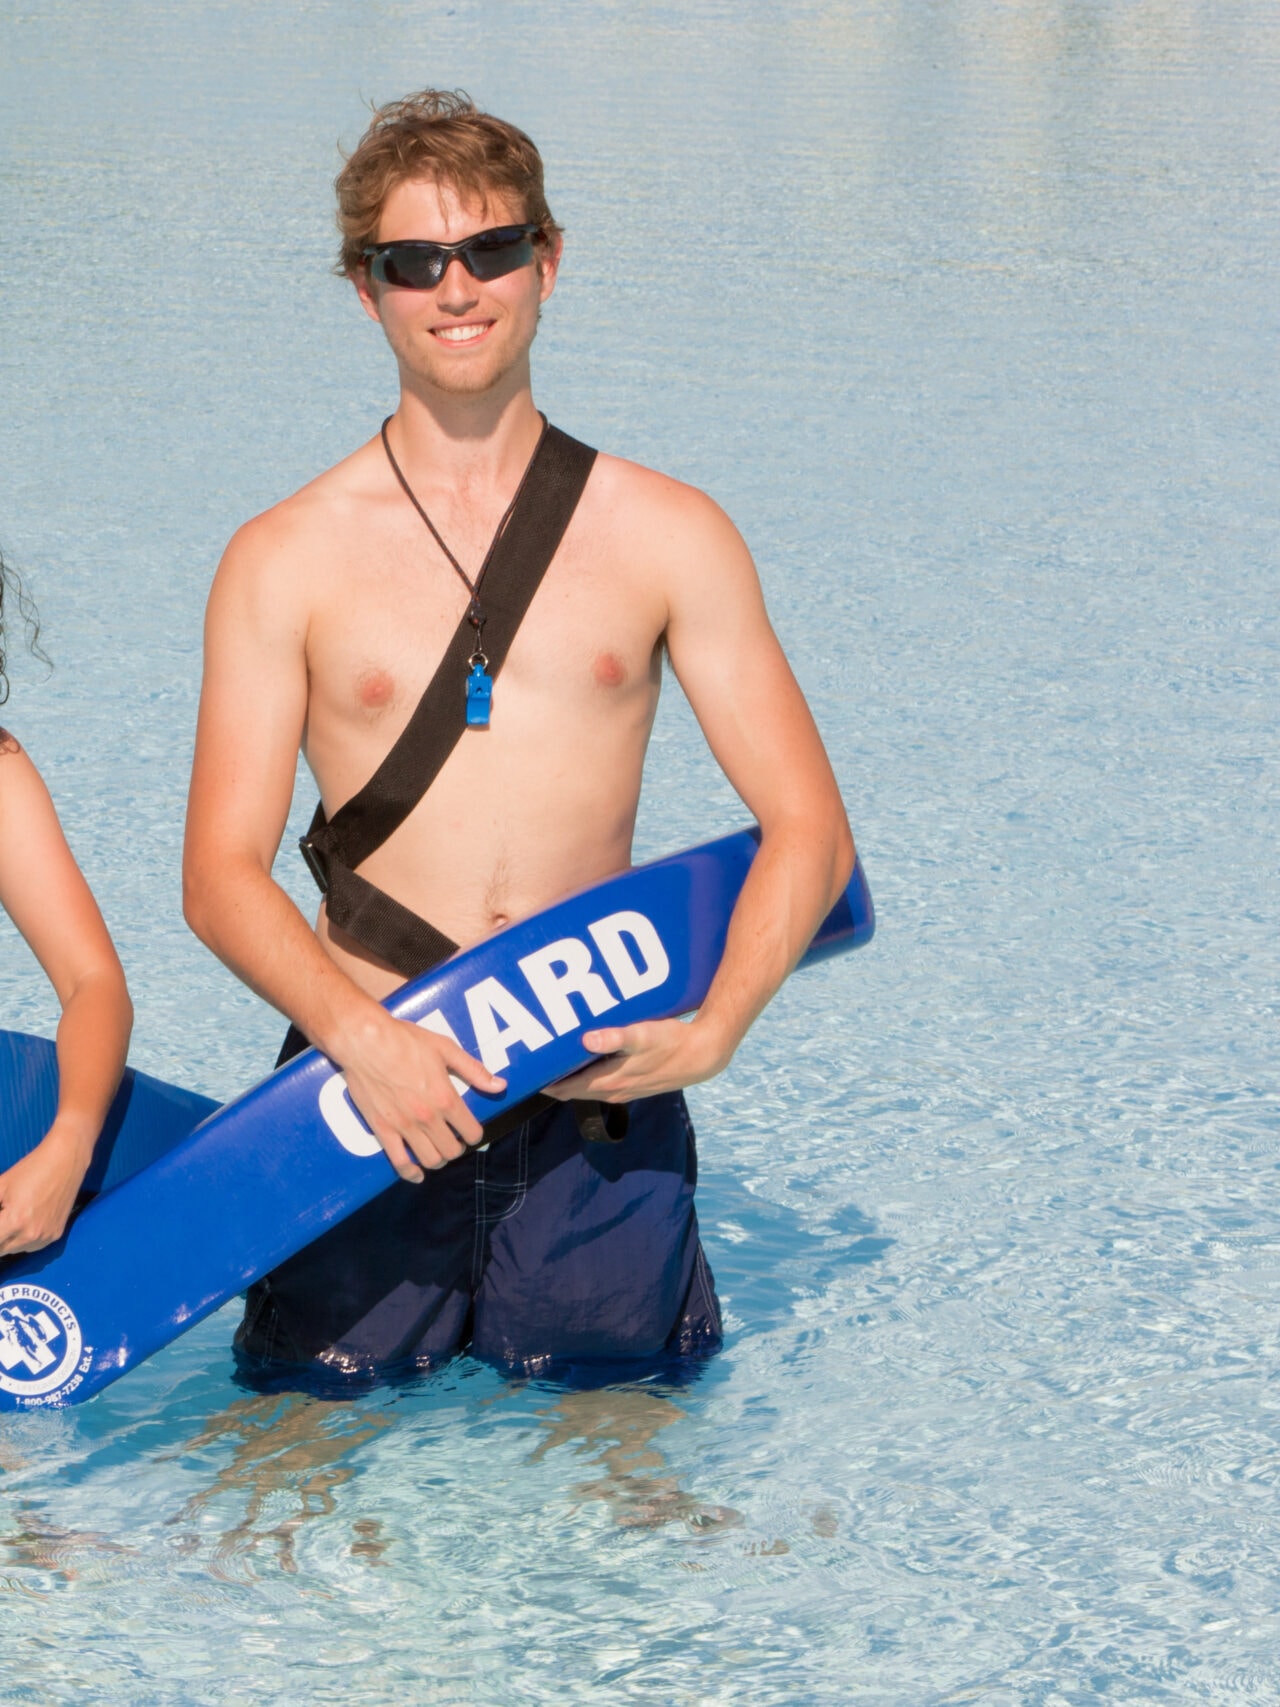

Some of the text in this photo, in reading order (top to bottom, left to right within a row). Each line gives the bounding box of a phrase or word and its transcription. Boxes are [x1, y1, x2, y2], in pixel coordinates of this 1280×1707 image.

[11, 1287, 77, 1331] PRODUCTS
[83, 1345, 94, 1355] 4
[79, 1354, 94, 1374] Ext.
